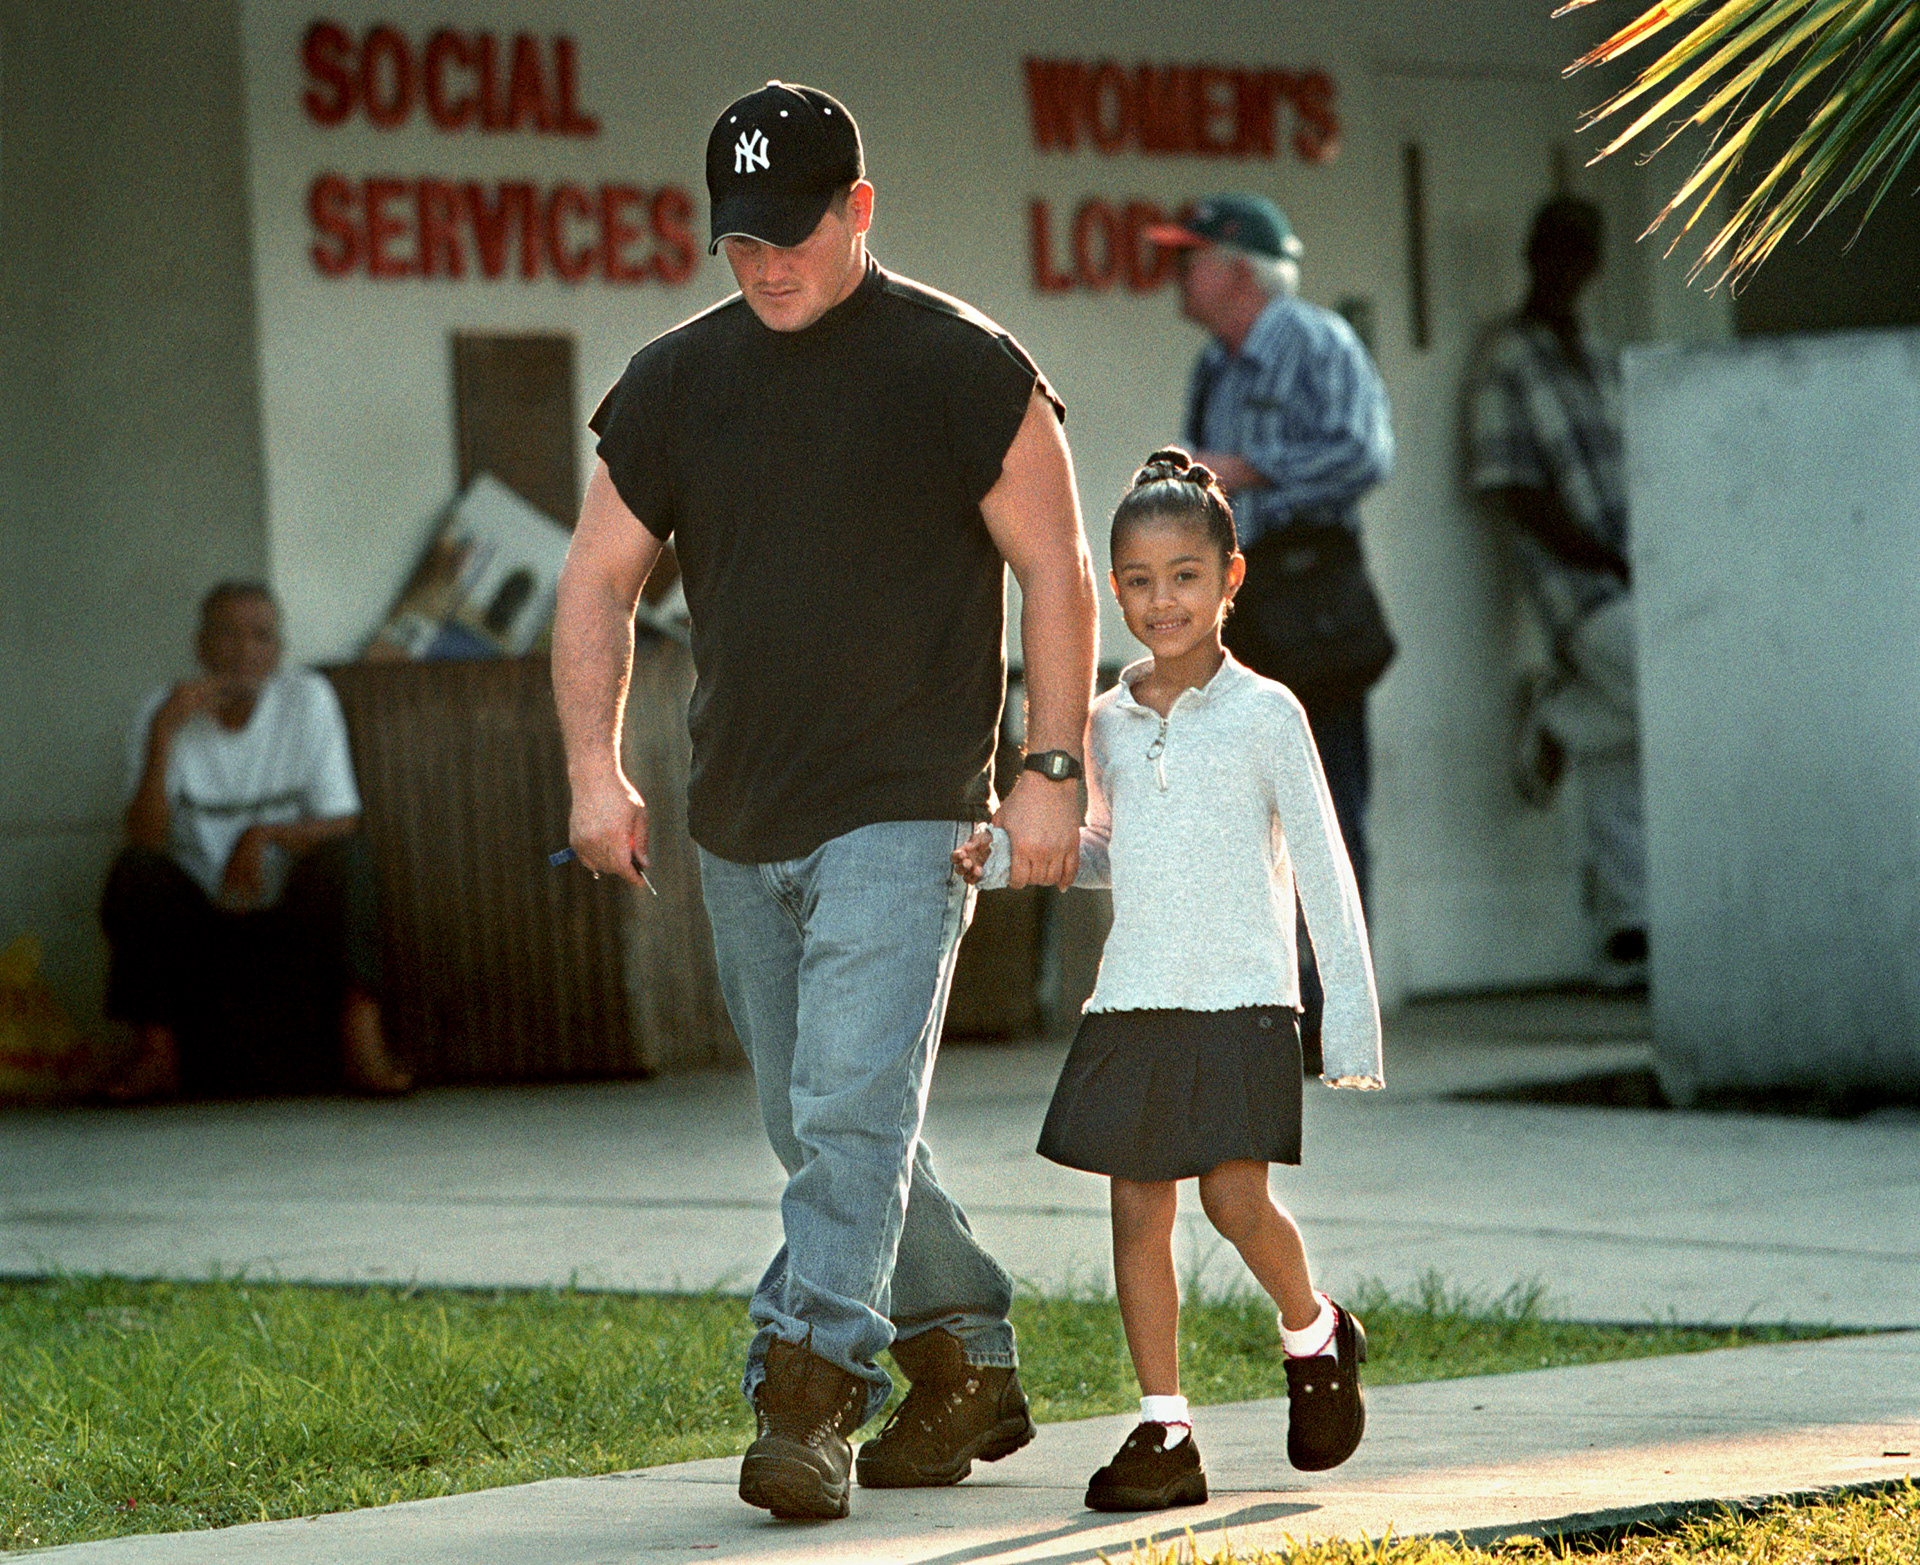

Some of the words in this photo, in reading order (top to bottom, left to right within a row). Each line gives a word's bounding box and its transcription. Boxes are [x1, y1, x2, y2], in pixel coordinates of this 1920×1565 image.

[302, 19, 600, 137] SOCIAL
[1024, 54, 1340, 163] WOMEN'S
[734, 128, 771, 174] NY
[308, 172, 698, 286] SERVICES
[1029, 197, 1198, 293] LOD
